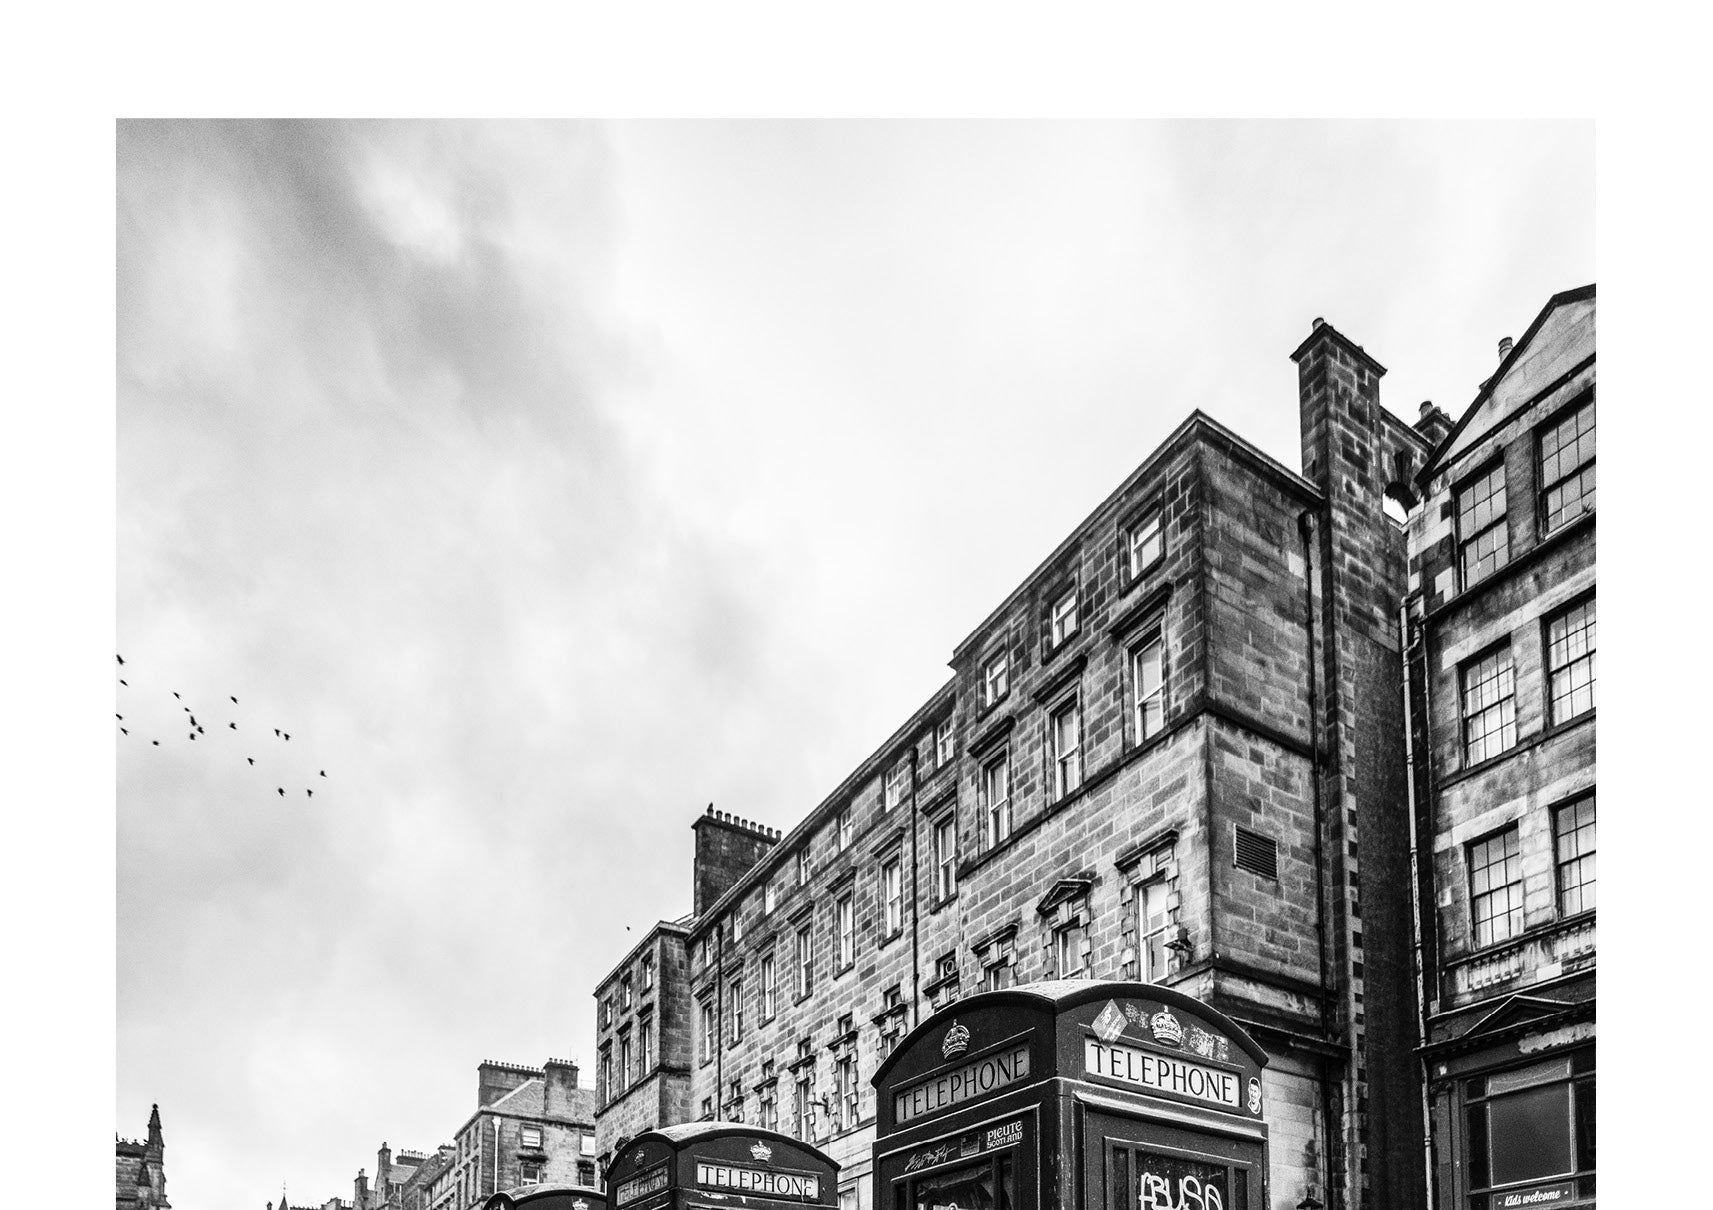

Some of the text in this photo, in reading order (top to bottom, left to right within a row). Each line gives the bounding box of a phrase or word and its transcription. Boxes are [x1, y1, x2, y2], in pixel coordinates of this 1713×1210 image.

[899, 1048, 1026, 1120] TELEPHONE
[1090, 1043, 1233, 1104] TELEPHONE
[701, 1165, 814, 1198] TELEPHONE
[1522, 1190, 1561, 1204] welcome
